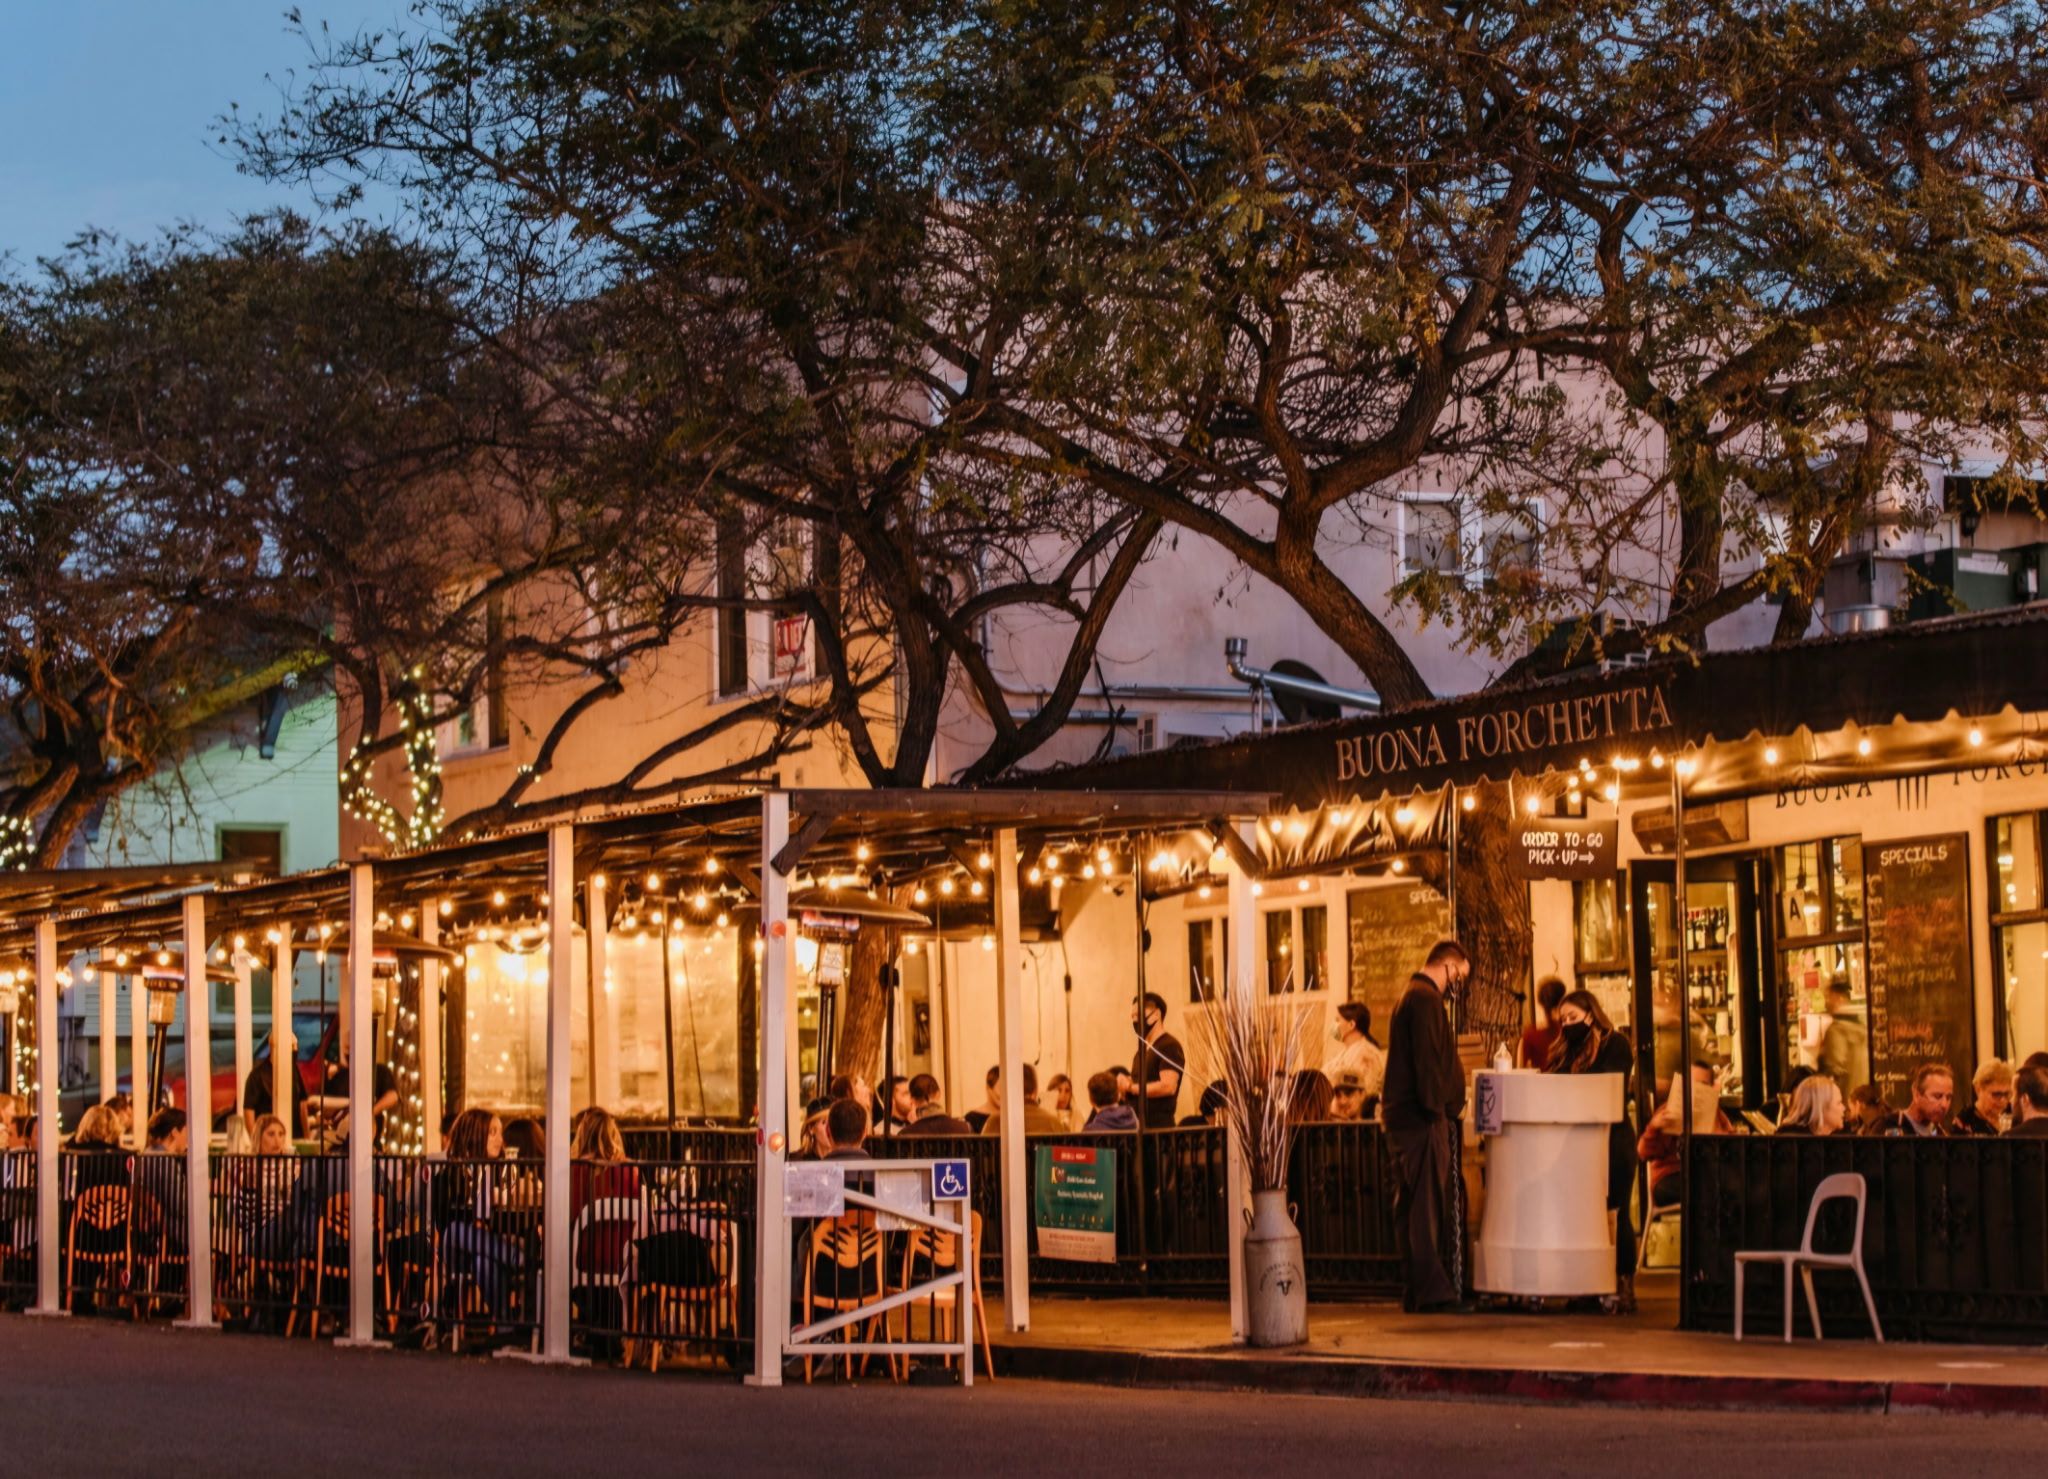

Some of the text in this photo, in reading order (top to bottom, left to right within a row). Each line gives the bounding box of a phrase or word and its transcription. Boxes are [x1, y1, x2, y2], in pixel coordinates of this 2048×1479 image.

[1336, 686, 1674, 781] BUONA FORCHETTA
[1522, 831, 1559, 848] ORDER
[1880, 844, 1948, 867] SPECIALS
[1789, 896, 1801, 920] A
